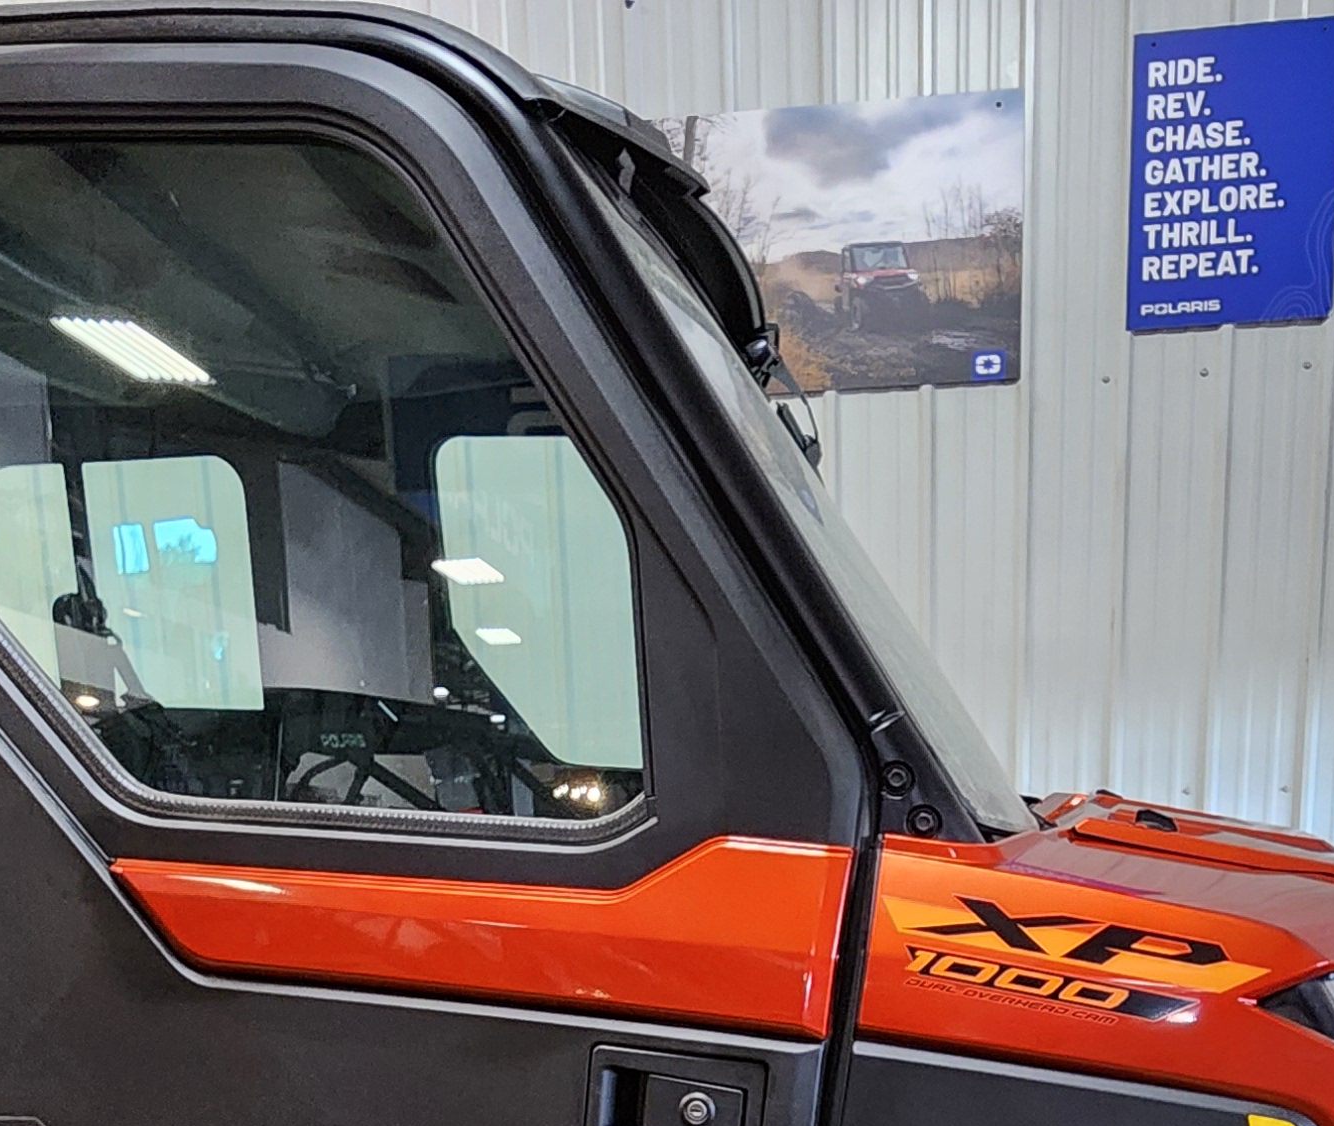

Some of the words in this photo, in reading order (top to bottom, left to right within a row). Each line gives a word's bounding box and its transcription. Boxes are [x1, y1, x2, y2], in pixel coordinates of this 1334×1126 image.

[1147, 56, 1223, 88] RIDE.
[1146, 90, 1212, 121] REV.
[1145, 119, 1251, 153] CHASE.
[1144, 152, 1267, 185] GATHER.
[1143, 182, 1285, 219] EXPLORE.
[1142, 218, 1253, 250] THRILL.
[1141, 248, 1259, 282] REPEAT.
[1140, 299, 1221, 316] POLARIS
[901, 894, 1232, 965] XP
[905, 950, 1130, 1010] 1000
[905, 978, 956, 994] DUAL
[962, 989, 1071, 1015] OVERHEAD
[1071, 1009, 1119, 1026] CAM
